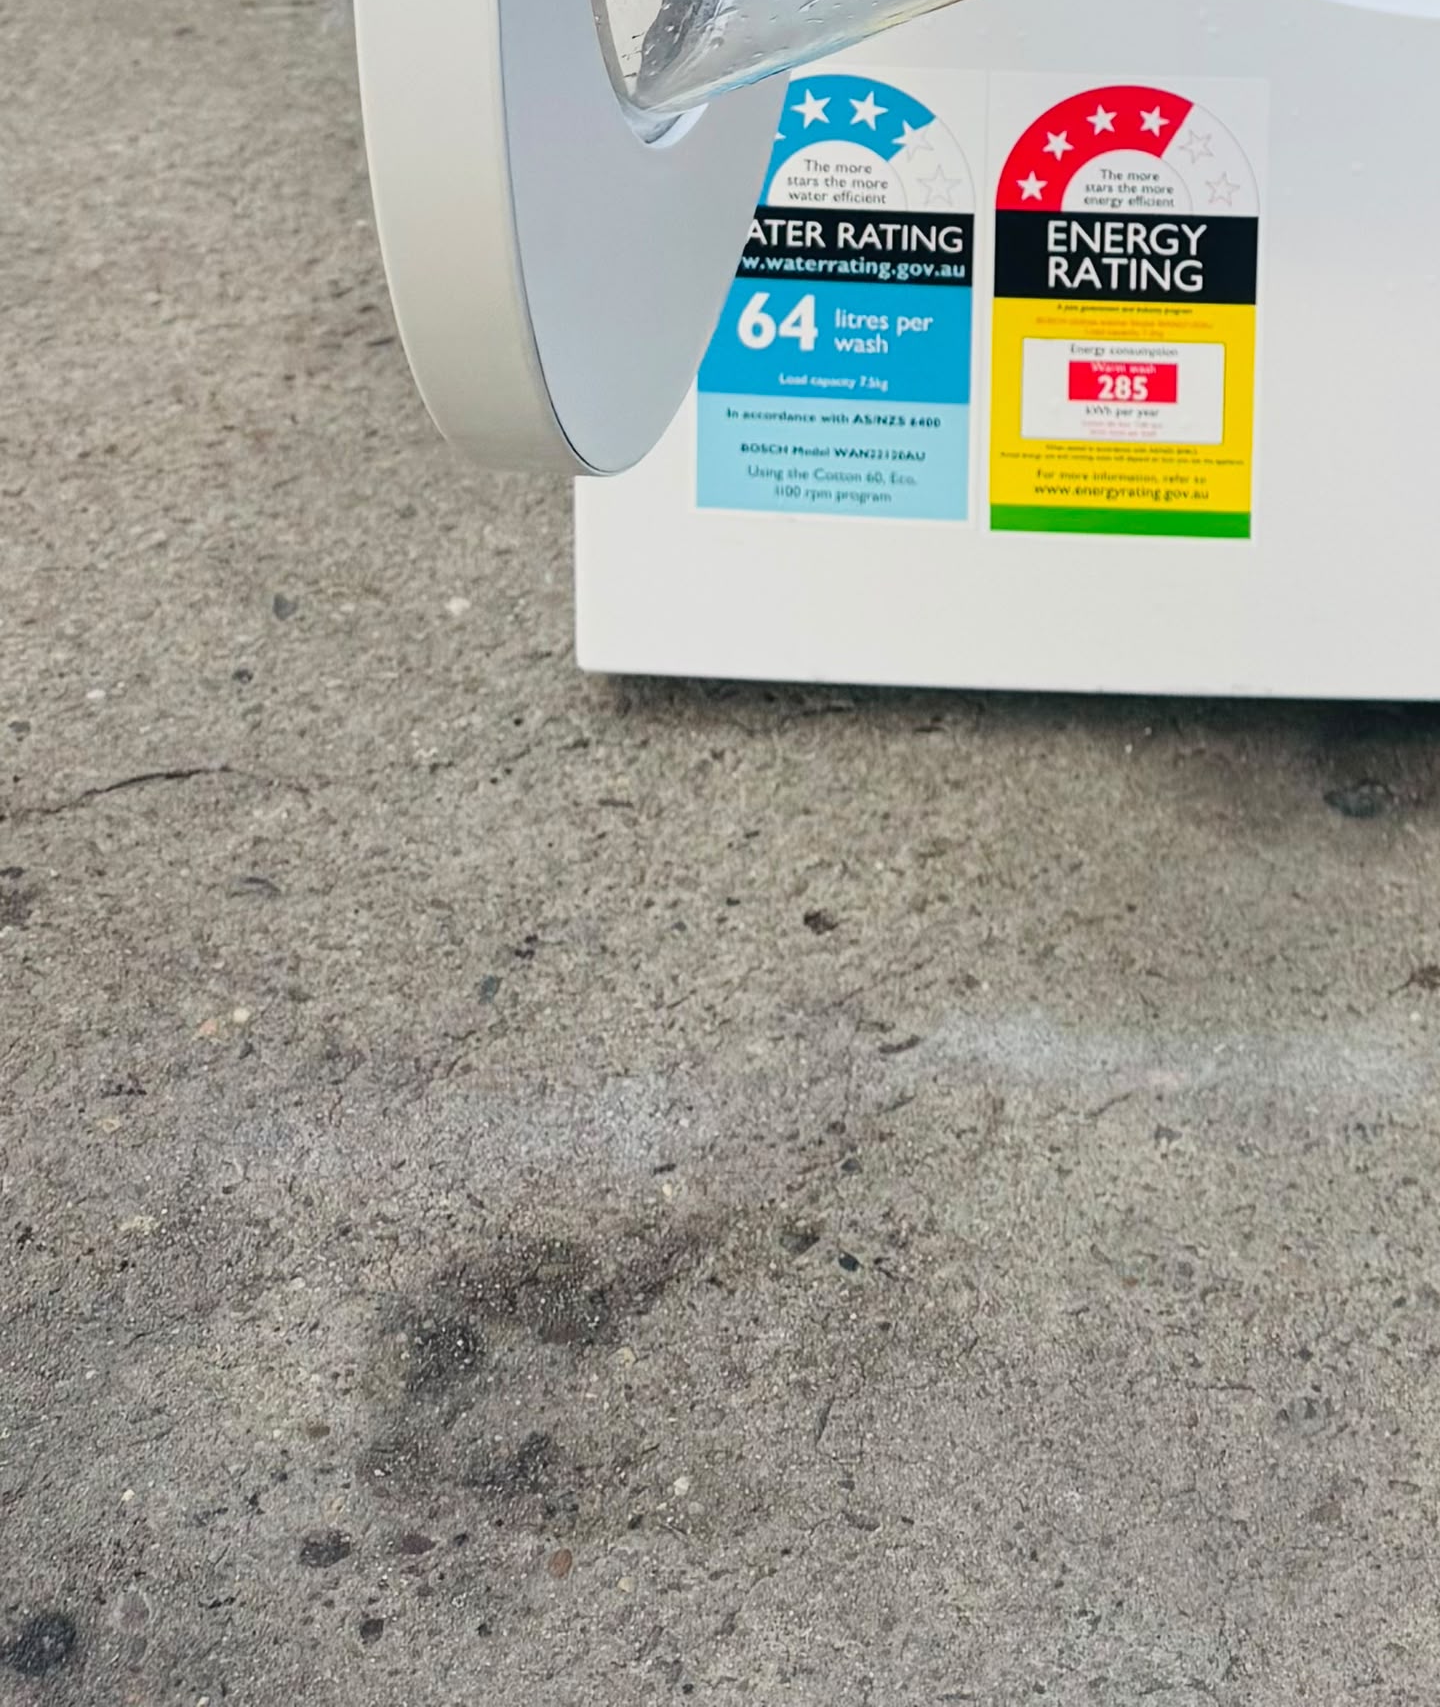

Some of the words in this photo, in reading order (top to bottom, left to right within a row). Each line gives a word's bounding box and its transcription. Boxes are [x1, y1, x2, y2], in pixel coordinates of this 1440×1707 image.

[804, 159, 830, 173] The
[835, 163, 872, 175] more
[1100, 168, 1124, 181] The
[1127, 171, 1160, 182] more
[787, 176, 819, 188] stars
[825, 177, 847, 188] the
[852, 178, 889, 190] more
[1085, 183, 1114, 193] stars
[1118, 182, 1138, 194] the
[1141, 184, 1174, 195] more
[789, 191, 827, 203] water
[833, 191, 887, 205] efficient
[1083, 195, 1124, 209] energy
[1128, 195, 1175, 208] efficient
[747, 218, 826, 248] ATER
[837, 221, 964, 254] RATING
[1047, 220, 1208, 256] ENERGY
[742, 255, 966, 280] w.waterrating.gov.au
[1047, 255, 1205, 292] RATING
[737, 291, 819, 351] 64
[834, 308, 890, 330] litres
[896, 315, 934, 336] per
[834, 334, 889, 354] wash
[1071, 343, 1105, 357] Energy
[1109, 345, 1179, 358] consumption
[1091, 361, 1127, 373] Warm
[779, 372, 808, 386] Load
[810, 375, 856, 389] capacity
[1097, 374, 1149, 401] 285
[726, 407, 739, 419] In
[743, 409, 816, 423] accordance
[821, 412, 849, 424] with
[852, 413, 905, 427] AS/NZS
[1116, 408, 1134, 418] per
[1137, 409, 1160, 419] year
[740, 443, 789, 455] BOSCH
[792, 445, 830, 457] Model
[748, 464, 784, 481] Using
[788, 467, 809, 480] the
[813, 467, 862, 483] Cotton
[1036, 468, 1054, 480] For
[1060, 471, 1088, 481] more
[1162, 474, 1190, 485] refer
[805, 488, 832, 502] rpm
[836, 489, 892, 504] program
